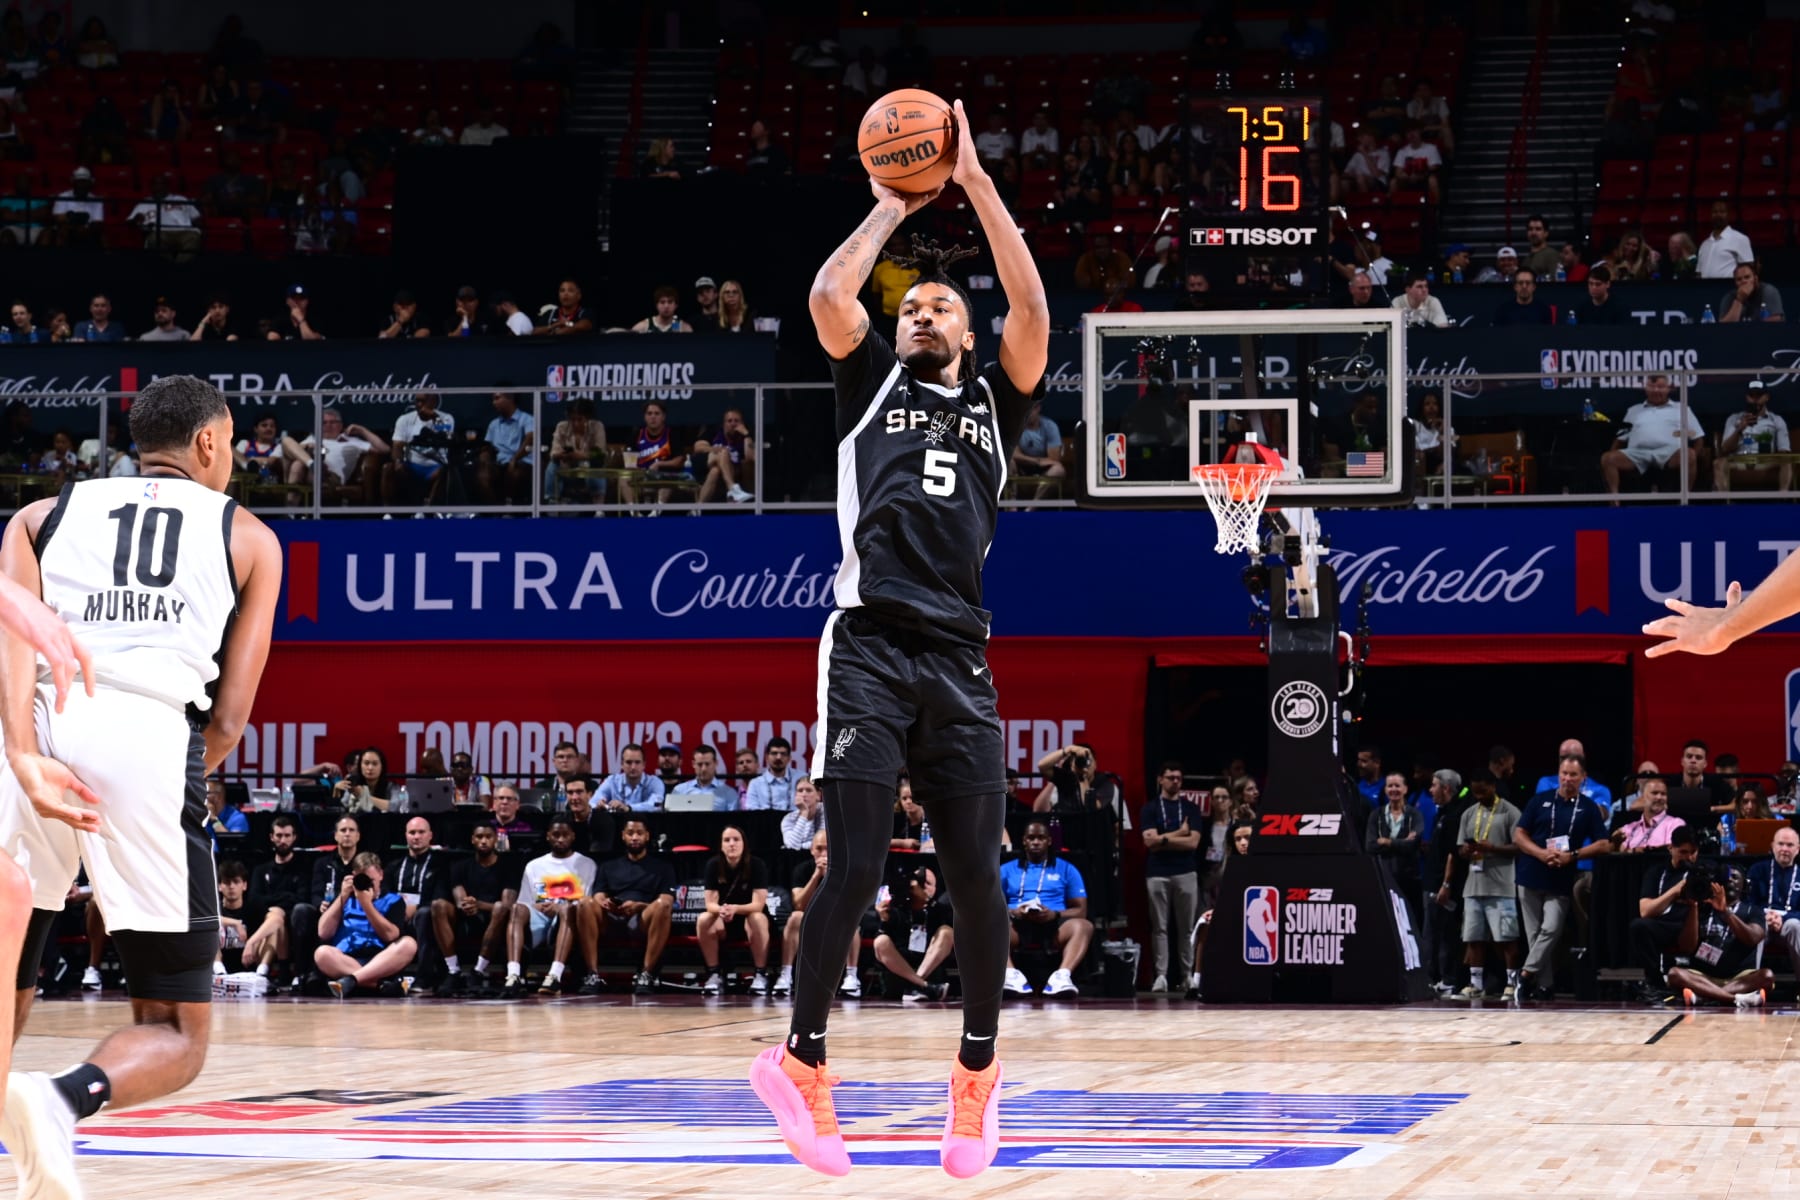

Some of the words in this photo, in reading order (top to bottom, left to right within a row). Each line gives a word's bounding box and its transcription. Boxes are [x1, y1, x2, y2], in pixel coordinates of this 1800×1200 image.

[1227, 106, 1309, 141] 7:51
[870, 139, 939, 168] Wilson
[1239, 146, 1301, 212] 16
[1225, 228, 1317, 245] TISSOT
[566, 362, 694, 401] EXPERIENCES
[1561, 349, 1698, 388] EXPERIENCES
[152, 371, 299, 406] TRA
[922, 449, 958, 497] 5
[108, 503, 184, 588] 10
[346, 551, 623, 613] ULTRA
[651, 549, 841, 617] Courtsi
[1325, 546, 1556, 604] Michelob
[1639, 540, 1800, 604] ULT
[83, 589, 185, 624] MURRAY
[1259, 814, 1342, 835] 2K25
[1286, 888, 1334, 901] 2K25
[1285, 903, 1357, 934] SUMMER
[1284, 934, 1345, 965] LEAGUE
